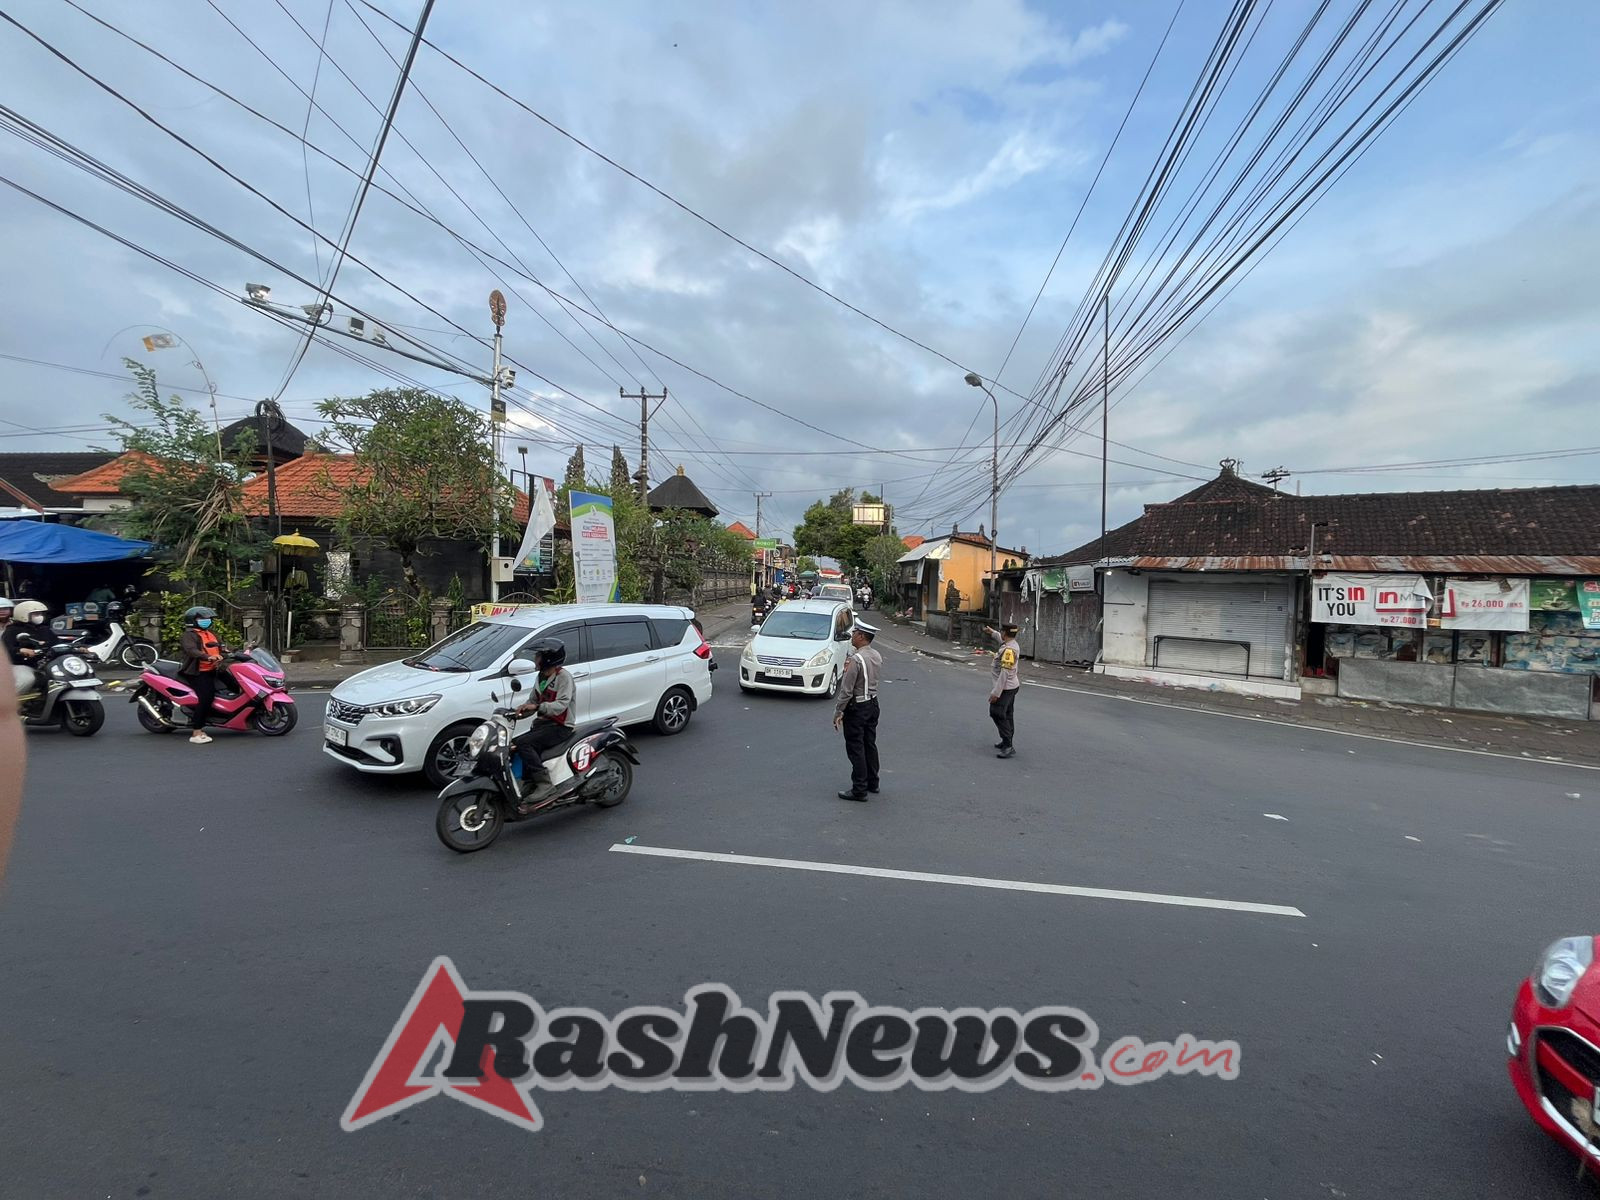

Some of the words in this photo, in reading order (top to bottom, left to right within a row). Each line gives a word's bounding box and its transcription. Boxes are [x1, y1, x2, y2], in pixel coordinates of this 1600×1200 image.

[1319, 587, 1345, 601] IT'S
[1327, 602, 1356, 616] YOU
[1471, 600, 1504, 608] 26.000
[1390, 616, 1417, 625] 27.000
